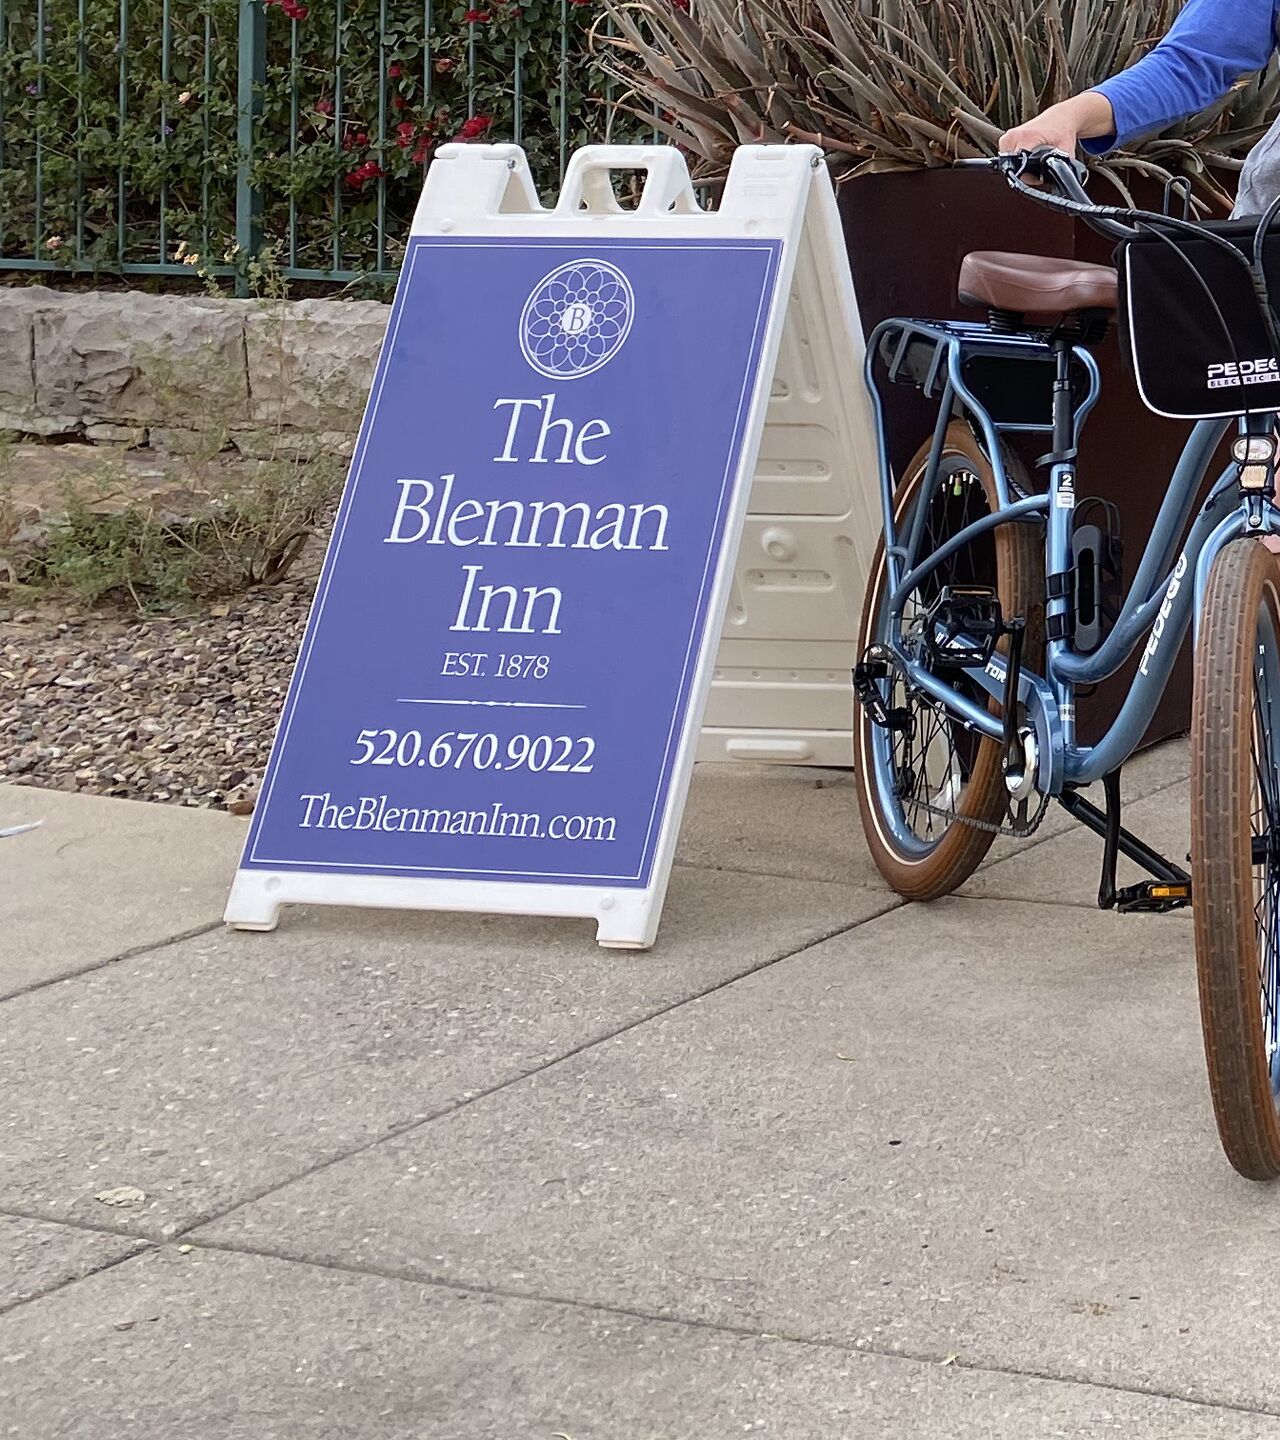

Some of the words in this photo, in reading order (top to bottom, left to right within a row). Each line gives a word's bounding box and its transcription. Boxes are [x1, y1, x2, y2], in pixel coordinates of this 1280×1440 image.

[569, 307, 585, 331] B
[1210, 374, 1265, 388] ELECRIC
[493, 393, 611, 465] The
[1062, 474, 1072, 487] 2
[383, 474, 669, 551] Blenman
[449, 565, 562, 634] Inn
[1139, 552, 1187, 676] PEDEGO
[441, 652, 488, 677] EST.
[494, 654, 550, 679] 1878
[350, 728, 596, 773] 520.670.9022
[298, 792, 617, 841] TheBlenmanInn.com
